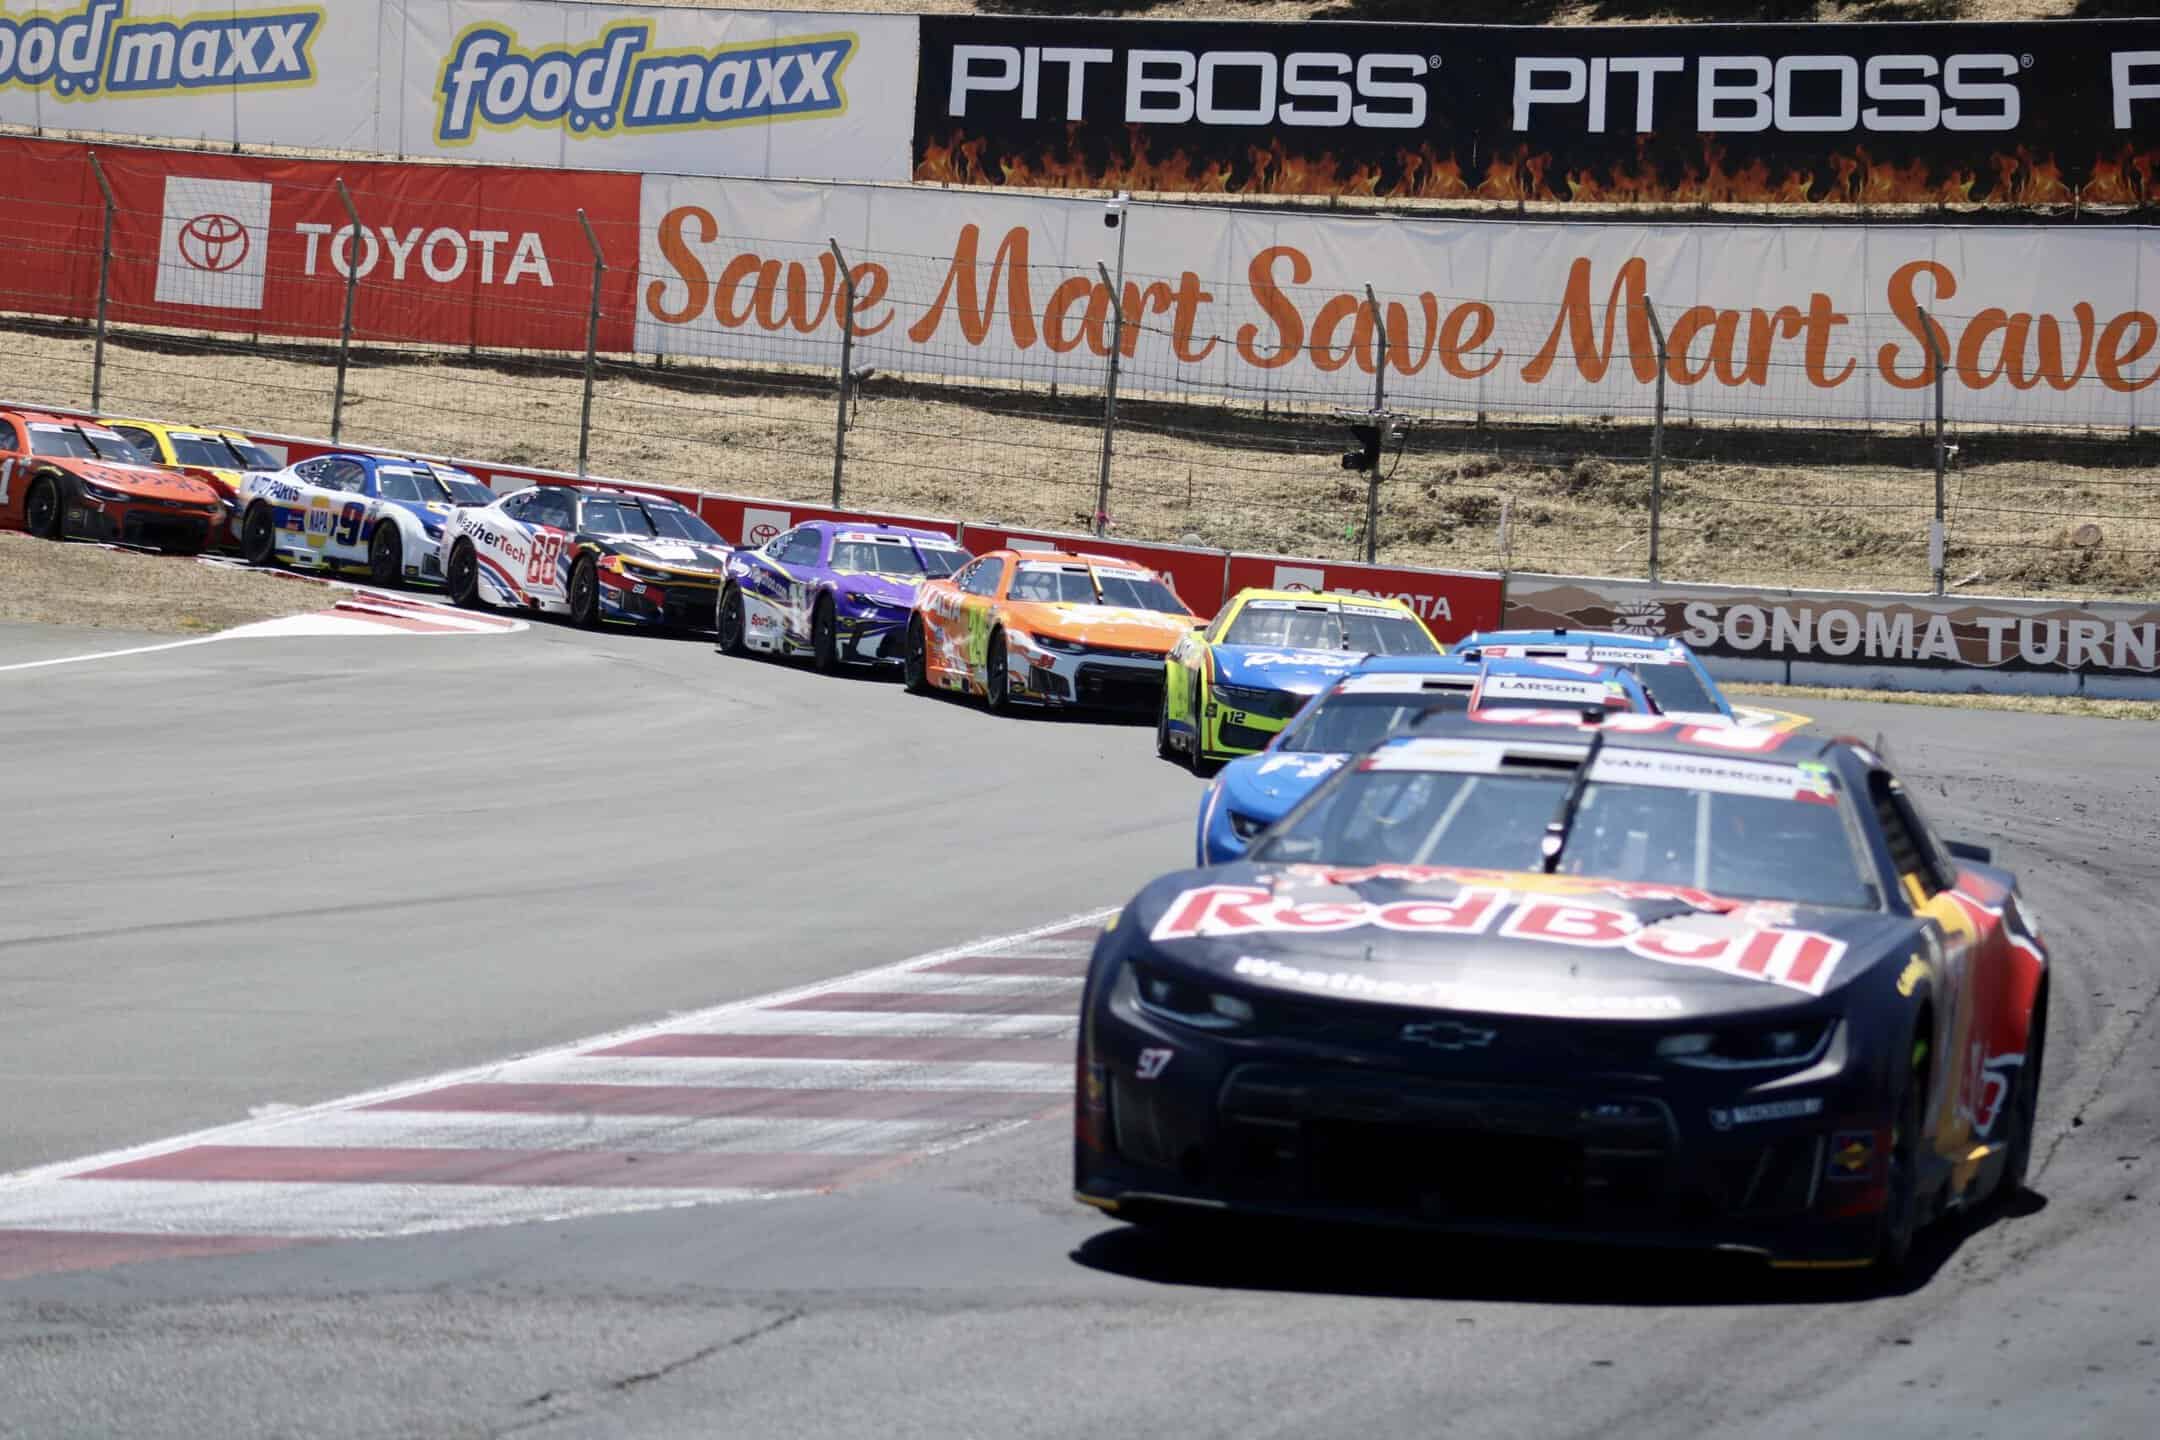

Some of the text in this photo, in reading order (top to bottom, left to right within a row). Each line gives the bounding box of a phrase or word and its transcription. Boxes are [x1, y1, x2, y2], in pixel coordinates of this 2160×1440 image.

[115, 26, 305, 82] maxx
[446, 33, 836, 131] food maxx
[949, 45, 1426, 128] PIT BOSS
[1513, 54, 2020, 132] PIT BOSS
[295, 222, 554, 287] TOYOTA
[646, 205, 2160, 392] Save Mart Save Mart Save
[337, 501, 366, 546] 9
[455, 509, 526, 566] WeatherTech
[526, 533, 564, 588] 88
[1334, 588, 1452, 621] OTA
[1683, 601, 1959, 660] SONOMA
[1500, 681, 1587, 695] LARSON
[1229, 711, 1247, 725] 12
[1601, 757, 1650, 769] VAN
[1150, 886, 1507, 941] Red
[1136, 1049, 1173, 1079] 97
